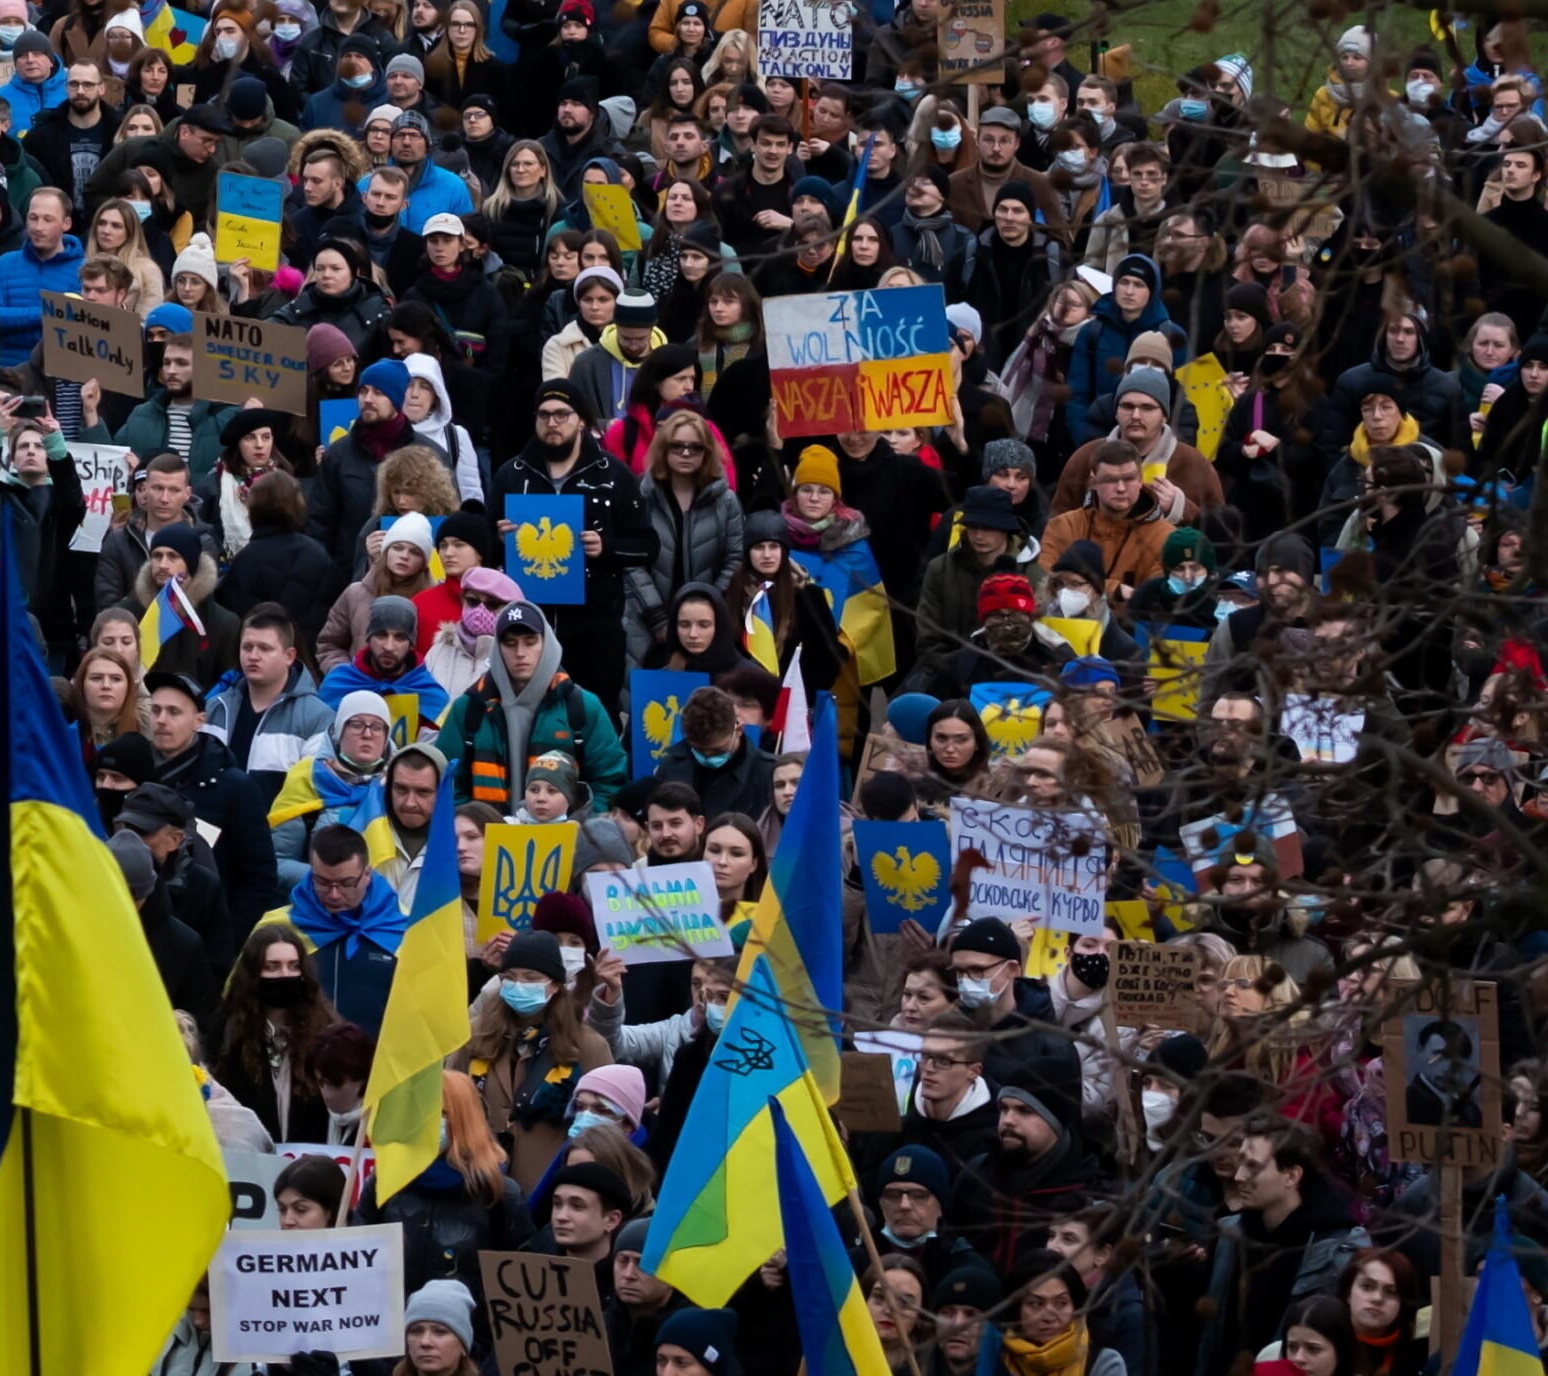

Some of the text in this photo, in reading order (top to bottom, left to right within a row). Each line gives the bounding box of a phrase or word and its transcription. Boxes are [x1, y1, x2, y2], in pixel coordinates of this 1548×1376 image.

[760, 0, 854, 31] NATO
[759, 48, 852, 64] NO ACTION
[759, 61, 850, 79] TALK ONLY
[825, 299, 884, 326] ZA
[204, 318, 263, 347] NATO
[786, 315, 929, 367] WOLNOŚĆ
[52, 328, 135, 376] Talk Only
[218, 360, 281, 389] SKY
[772, 375, 854, 420] NASZA
[864, 369, 952, 421] WASZA
[236, 1248, 379, 1277] GERMANY
[496, 1259, 571, 1301] CUT
[271, 1286, 349, 1310] NEXT
[239, 1314, 382, 1336] STOP WAR NOW
[489, 1299, 602, 1341] RUSSIA
[524, 1336, 578, 1367] OFF
